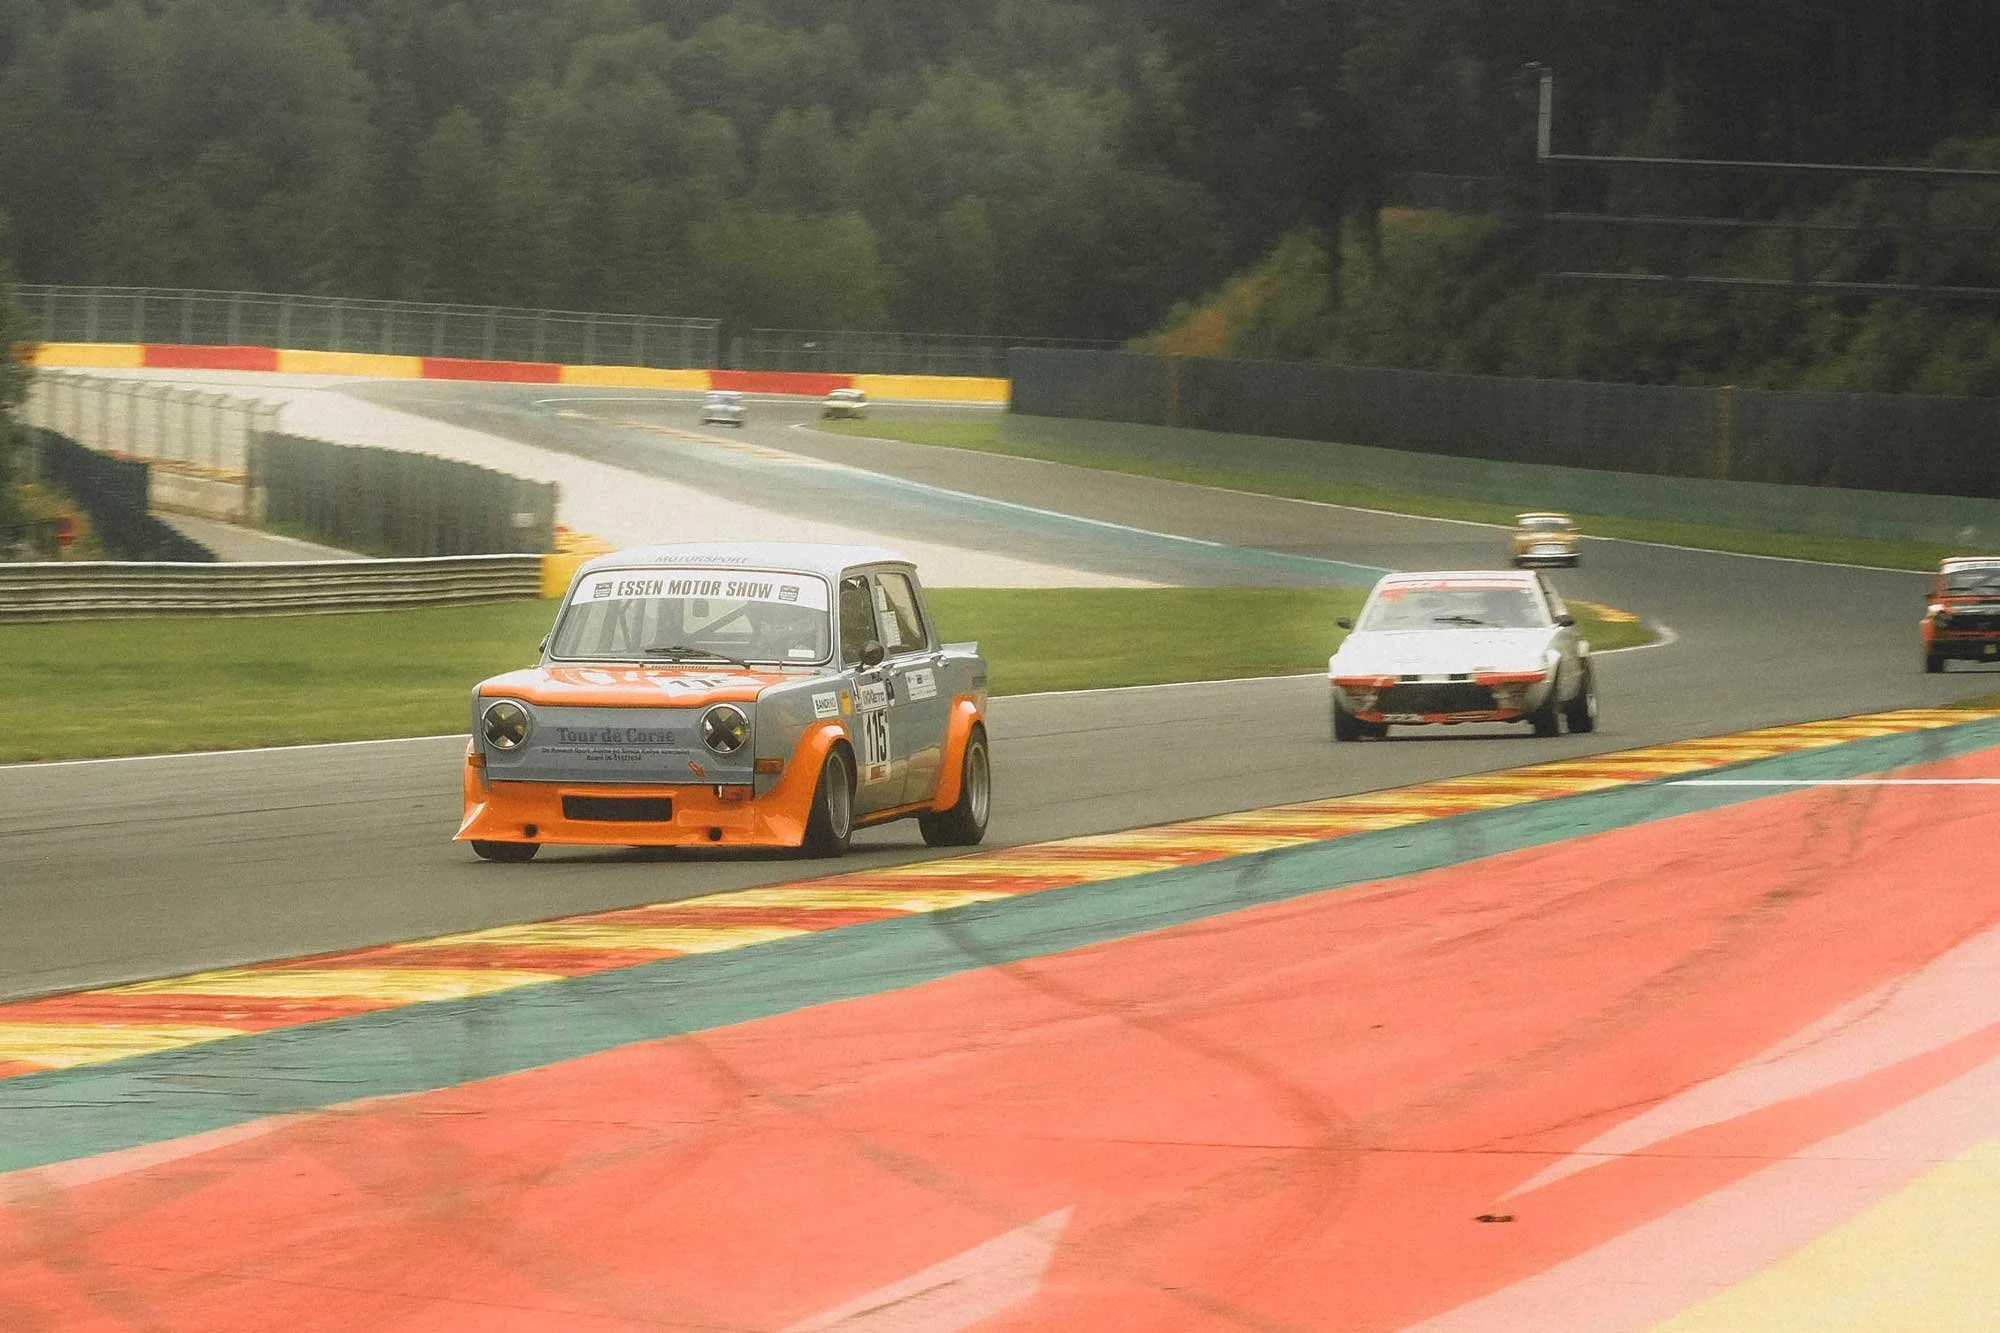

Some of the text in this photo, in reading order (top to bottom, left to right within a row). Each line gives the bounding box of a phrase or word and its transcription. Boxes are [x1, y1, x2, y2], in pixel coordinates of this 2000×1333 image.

[617, 580, 663, 597] ESSEN
[667, 580, 722, 597] MOTOR
[726, 581, 773, 599] SHOW
[557, 727, 675, 743] Tour de Corse
[866, 710, 888, 762] 115
